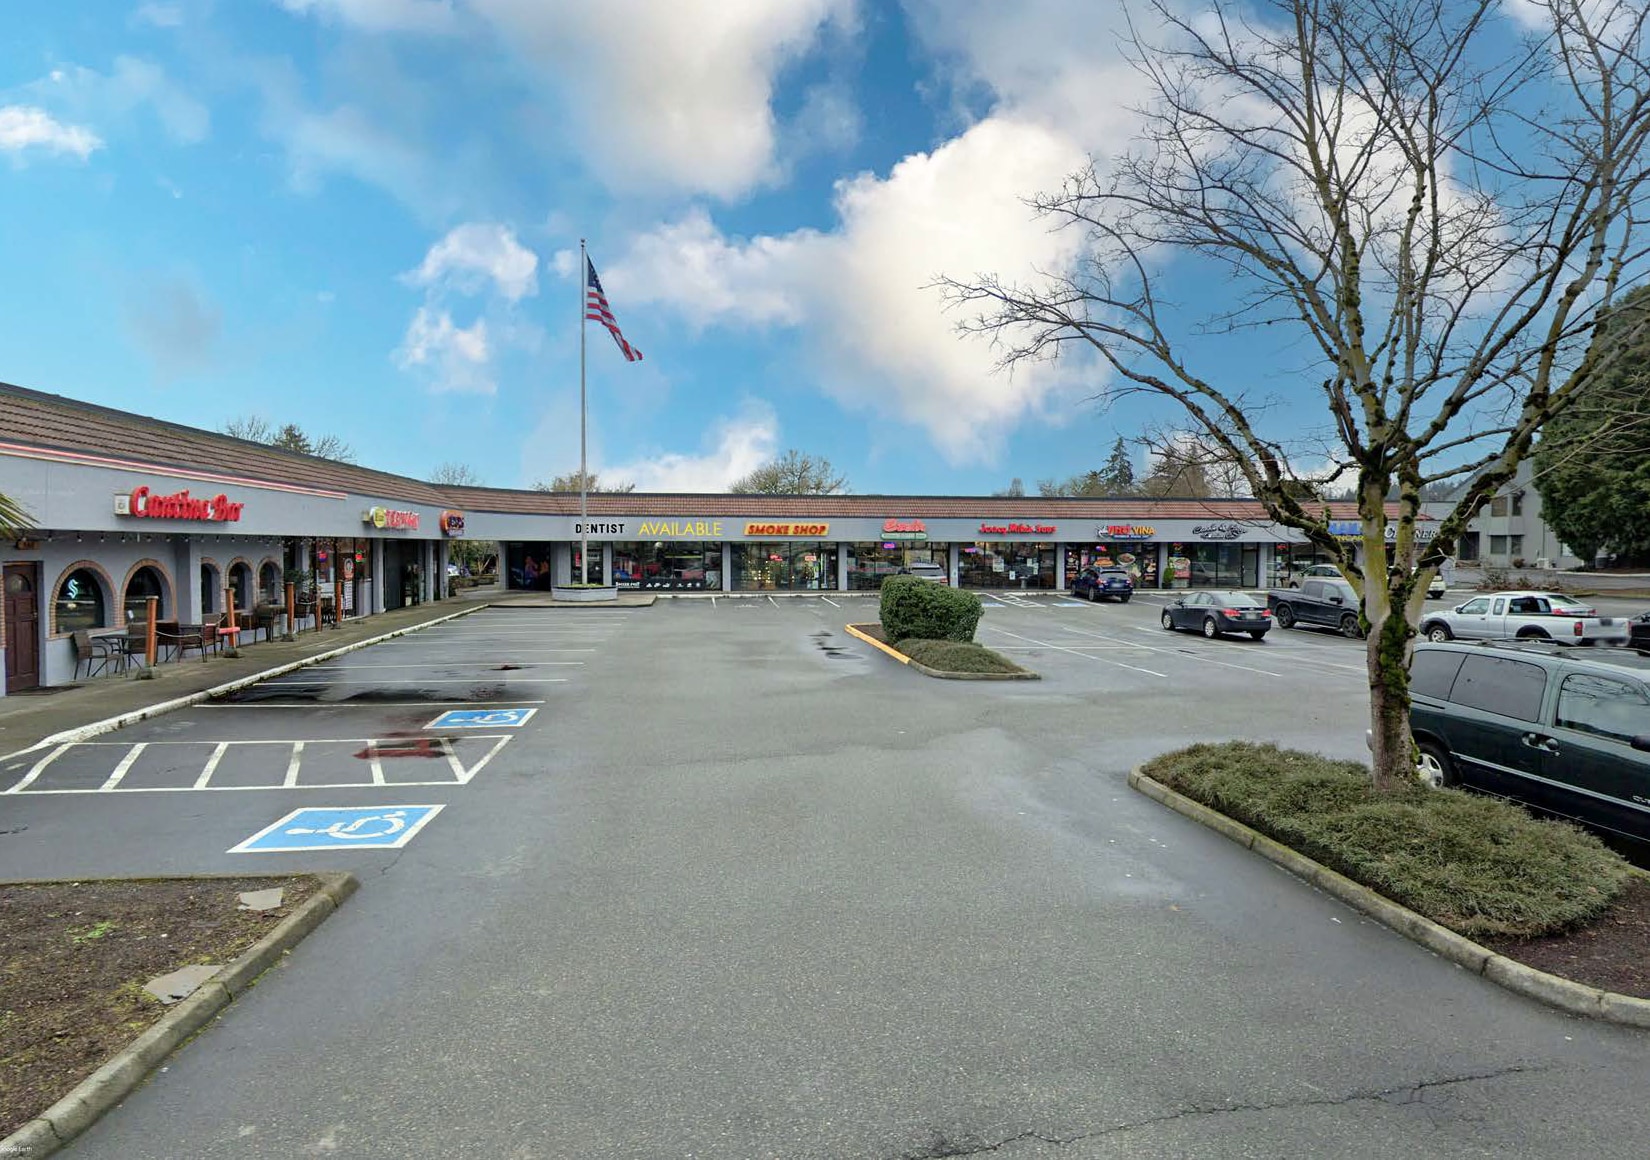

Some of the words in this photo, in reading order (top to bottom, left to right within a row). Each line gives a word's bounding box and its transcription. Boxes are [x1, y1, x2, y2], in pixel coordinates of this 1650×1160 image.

[130, 486, 209, 519] Cantina
[212, 493, 245, 522] Bar
[638, 521, 724, 537] AVAILABLE
[748, 525, 790, 535] SMOKE
[792, 525, 826, 535] SHOP
